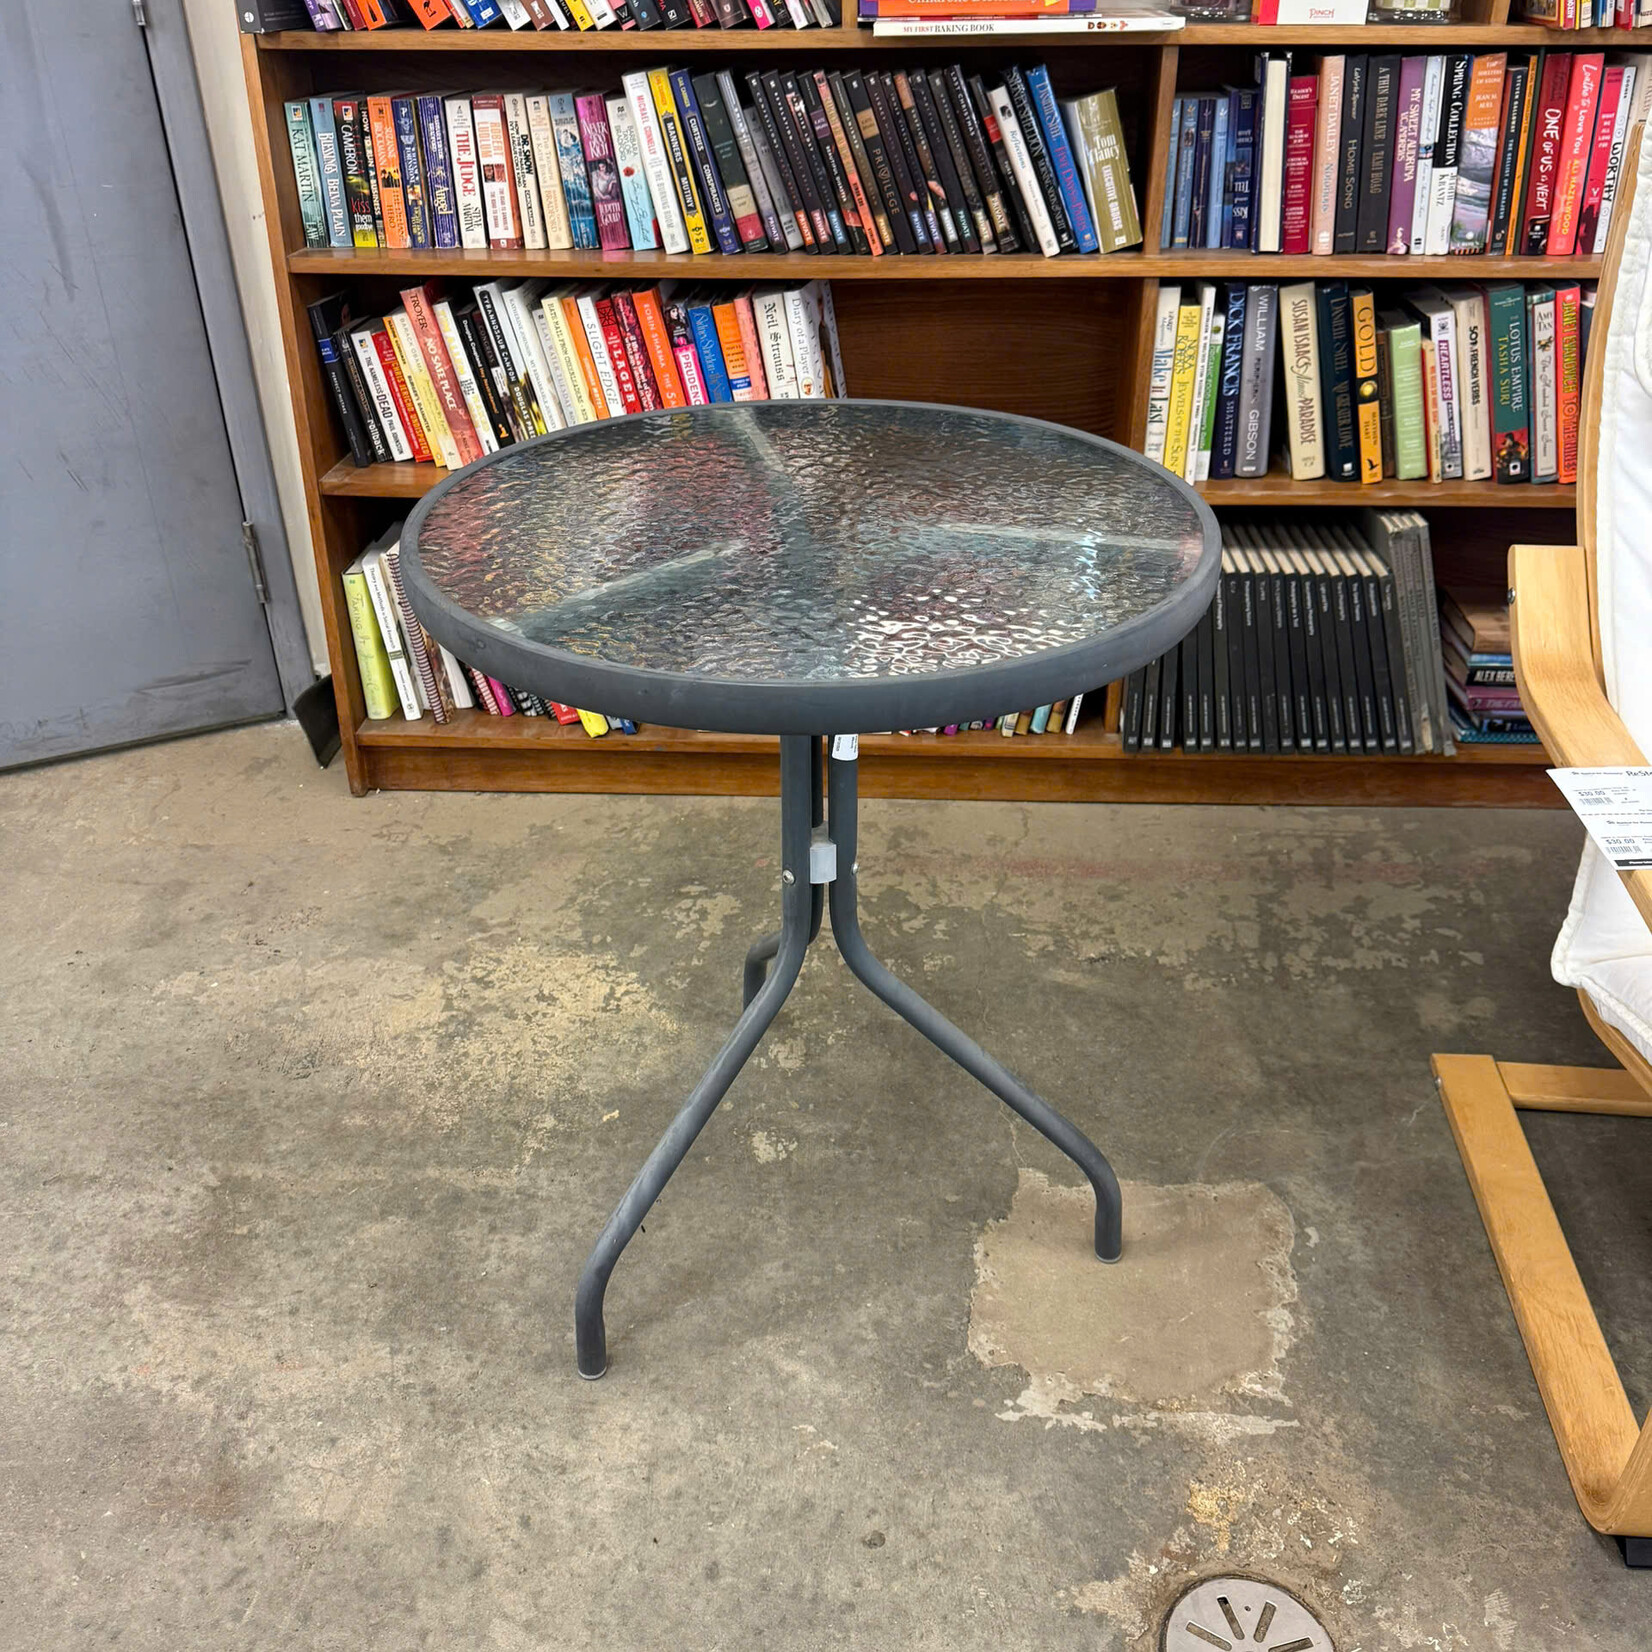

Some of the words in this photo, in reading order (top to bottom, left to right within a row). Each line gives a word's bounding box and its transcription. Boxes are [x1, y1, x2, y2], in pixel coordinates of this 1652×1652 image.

[934, 24, 968, 32] BAKING
[970, 24, 995, 32] BOOK
[1328, 74, 1341, 111] JANET
[1378, 74, 1390, 95] THIN
[1450, 60, 1467, 100] SPRING
[1514, 75, 1522, 100] STEVEN
[1578, 62, 1598, 96] Loathe
[636, 94, 650, 124] MICHAEL
[950, 70, 960, 92] LAST
[957, 93, 976, 138] CHRISTMAS
[1376, 96, 1389, 118] DARK
[1408, 103, 1420, 138] SWEET
[1510, 102, 1520, 134] GALLOWAY
[1576, 108, 1590, 132] Love
[361, 110, 370, 134] HOW
[490, 121, 504, 156] ROBERT
[688, 118, 704, 152] CURTSIES
[1019, 112, 1040, 160] SHELDON
[1326, 113, 1338, 154] DAILEY
[1374, 120, 1387, 140] LINE
[1444, 102, 1464, 166] COLLECTION
[1543, 108, 1562, 140] ONE
[292, 128, 306, 152] KAT
[318, 132, 338, 174] BLESSINGS
[341, 124, 358, 174] CAMERON
[455, 130, 470, 156] THE
[478, 121, 493, 158] LUDLUM
[614, 124, 626, 161] BRADFORD
[622, 130, 631, 154] TAYLOR
[627, 126, 638, 156] BARBARA
[642, 126, 657, 156] CONNELLY
[666, 122, 682, 164] MANNERS
[1010, 130, 1026, 170] Reflections
[1094, 134, 1116, 149] Tom
[1346, 139, 1358, 174] HOME
[1544, 142, 1554, 156] OF
[1573, 134, 1585, 155] You
[366, 148, 375, 168] RUN
[523, 149, 534, 176] SNOW
[1372, 150, 1385, 171] TAMI
[1404, 138, 1419, 182] AUDRINA
[1505, 153, 1514, 178] CELLIST
[1540, 155, 1553, 172] US
[1602, 141, 1622, 202] WORTHY
[296, 154, 314, 203] MARTIN
[326, 178, 340, 208] BELVA
[456, 157, 477, 198] JUDGE
[680, 177, 695, 209] MUTINY
[702, 164, 722, 214] CONSPIRACIES
[872, 148, 900, 216] PRIVILEGE
[1102, 164, 1118, 202] EXECUTIVE
[1344, 176, 1356, 210] SONG
[1436, 174, 1450, 206] KRANTZ
[351, 199, 371, 213] kiss
[370, 180, 382, 216] BUSINESS
[434, 184, 454, 215] Angel
[656, 182, 670, 210] BURNING
[664, 210, 675, 230] ROOM
[991, 197, 1006, 230] PRIVATE
[1499, 189, 1510, 220] SARAJEVO
[1536, 184, 1551, 210] NEXT
[1562, 174, 1580, 236] HAZELWOOD
[330, 208, 346, 238] PLAIN
[463, 202, 475, 232] MARTINI
[766, 216, 780, 242] PRIVATE
[798, 212, 813, 242] PRIVATE
[812, 212, 828, 240] PRIVATE
[830, 212, 846, 242] PRIVATE
[878, 218, 891, 244] PRIVATE
[912, 214, 926, 242] PRIVATE
[926, 213, 941, 240] PRIVATE
[942, 212, 957, 241] PRIVATE
[958, 210, 971, 238] PRIVATE
[974, 212, 988, 240] PRIVATE
[1109, 203, 1123, 232] ORDERS
[410, 294, 428, 331] TROYER
[508, 298, 524, 332] KATHERINE
[552, 320, 563, 338] MAIL
[764, 302, 780, 328] Neil
[1228, 291, 1246, 333] DICK
[1254, 294, 1270, 352] WILLIAM
[1292, 299, 1308, 334] SUSAN
[1536, 311, 1554, 322] AMY
[1538, 322, 1553, 332] TAN
[1562, 300, 1577, 333] JANET
[398, 318, 412, 348] BARACK
[408, 348, 424, 374] OBAMA
[424, 338, 438, 355] NO
[462, 319, 474, 342] Douglas
[468, 342, 483, 368] Coupland
[478, 325, 496, 365] CONGRESS
[482, 294, 506, 350] TYRANNOSAUR
[500, 350, 517, 382] CANYON
[557, 338, 570, 356] FROM
[644, 303, 656, 330] ROBIN
[652, 332, 666, 369] SHARMA
[792, 298, 802, 326] Diary
[799, 346, 810, 376] Player
[1294, 333, 1312, 370] ISAACS
[1356, 306, 1376, 373] GOLD
[1508, 321, 1522, 364] LOTUS
[430, 356, 448, 380] SAFE
[586, 323, 608, 368] SLIGHT
[600, 368, 619, 406] EDGE
[770, 331, 786, 382] Strauss
[1153, 348, 1174, 384] Make
[1176, 334, 1190, 376] ROBERTS
[1184, 339, 1198, 371] NORA
[1222, 333, 1243, 396] FRANCIS
[1438, 341, 1452, 400] HEARTLESS
[1470, 347, 1480, 382] FRENCH
[1498, 334, 1509, 375] TASHA
[1562, 335, 1578, 394] EVANOVICH
[331, 372, 341, 395] PERFECT
[337, 395, 348, 416] MISTAKE
[366, 366, 384, 395] NAMELESS
[376, 394, 394, 420] DEAD
[554, 372, 571, 408] TUESDAY
[612, 350, 636, 404] LAGER
[1471, 382, 1481, 406] VERBS
[1499, 378, 1511, 406] SURI
[1510, 366, 1524, 412] EMPIRE
[391, 361, 402, 382] CHRIS
[408, 414, 431, 457] UNDISPUTED
[438, 380, 458, 410] PLACE
[513, 386, 530, 420] DOUGLAS
[1148, 396, 1169, 424] Last
[1174, 380, 1190, 416] JEWELS
[416, 402, 432, 434] DAUGHTER
[1223, 400, 1235, 456] SHATTERED
[1246, 409, 1260, 461] GIBSON
[1299, 398, 1316, 446] PARADISE
[368, 417, 386, 455] rollback
[390, 432, 404, 456] JOHNSTON
[352, 594, 364, 631] TAKING
[375, 591, 386, 612] Methods
[382, 616, 390, 629] Social
[1474, 670, 1496, 682] ALEX
